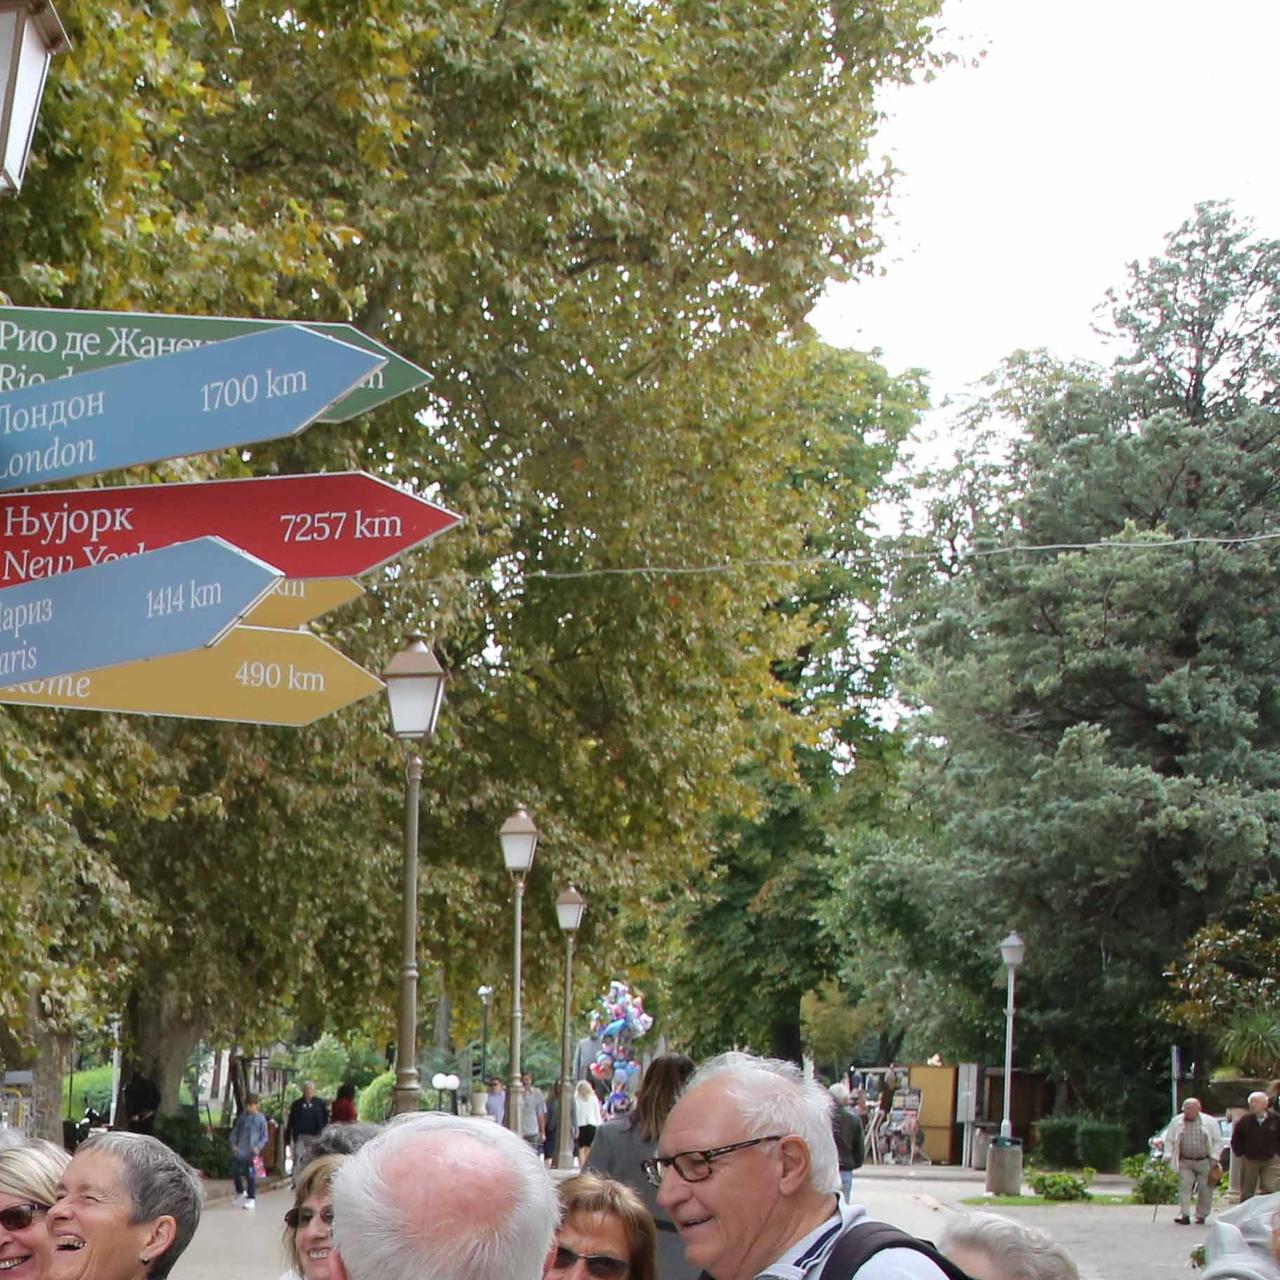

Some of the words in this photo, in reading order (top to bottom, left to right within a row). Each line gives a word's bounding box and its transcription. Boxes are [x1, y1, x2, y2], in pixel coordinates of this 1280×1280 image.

[62, 332, 101, 361] де
[106, 326, 219, 358] Жане
[200, 378, 259, 413] 1700
[265, 368, 309, 399] km
[3, 502, 134, 545] Њујорк
[279, 511, 347, 543] 7257
[354, 509, 403, 539] km
[2, 549, 75, 581] New
[82, 541, 147, 566] Yo
[146, 583, 185, 618] 1414
[190, 579, 223, 607] km
[6, 676, 91, 698] ome
[234, 661, 281, 688] 490
[287, 663, 326, 692] km
